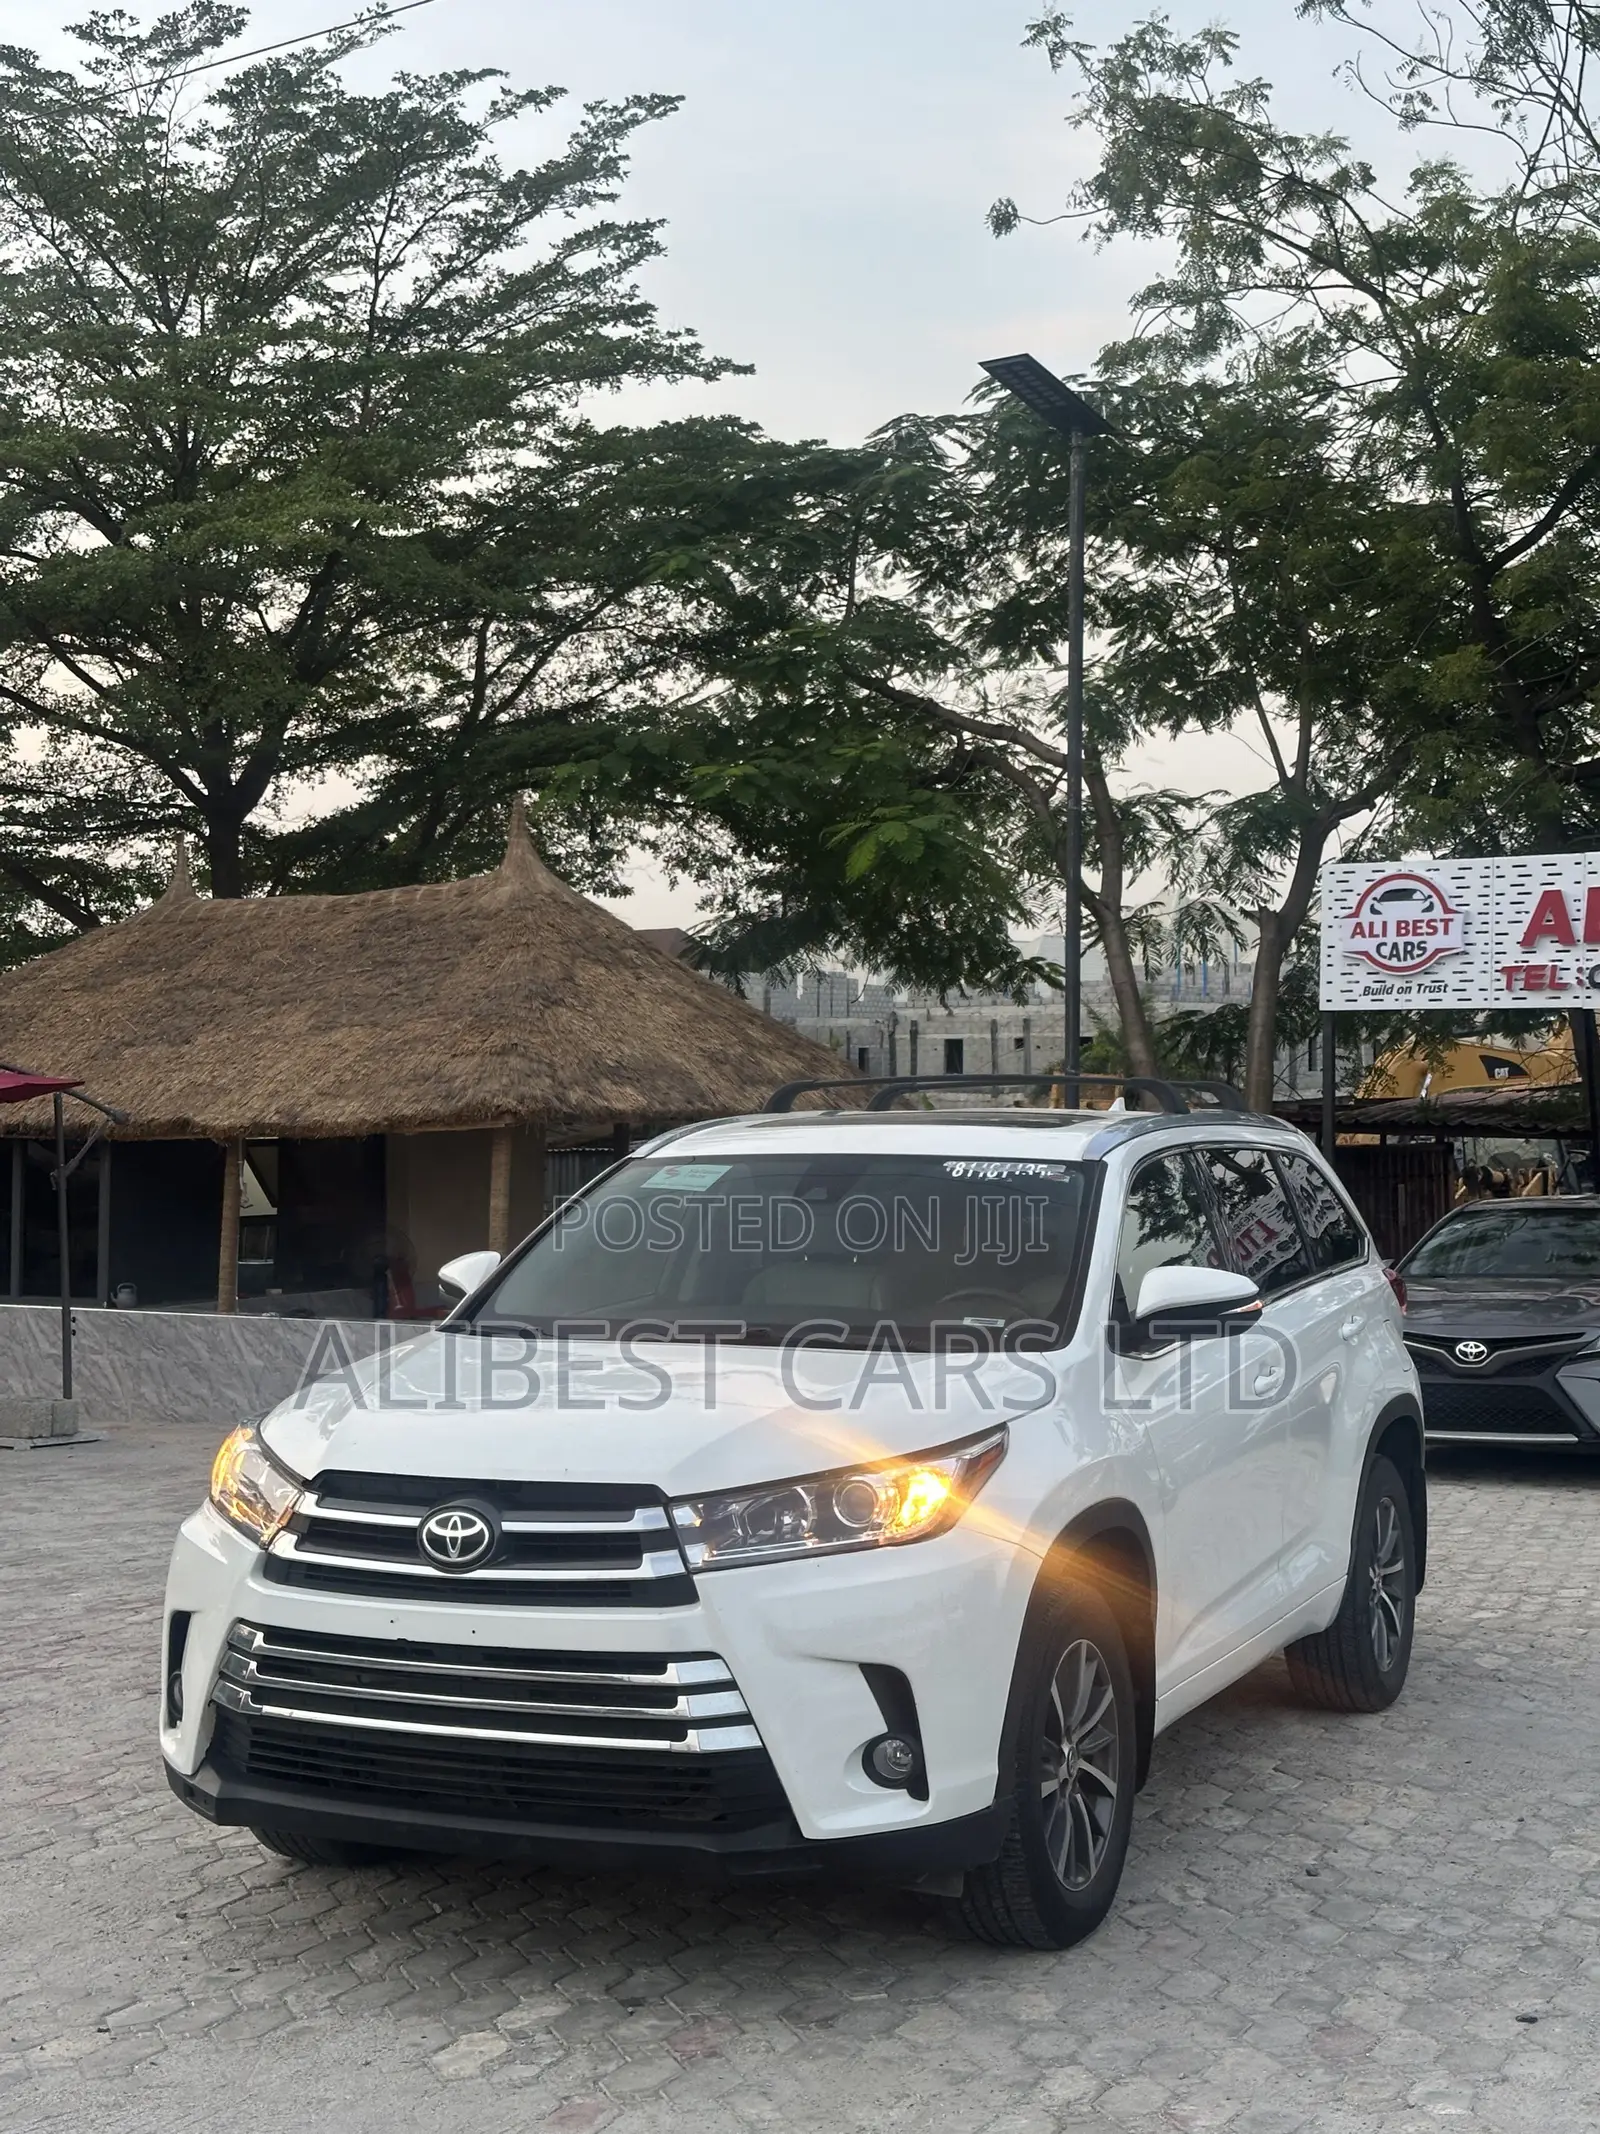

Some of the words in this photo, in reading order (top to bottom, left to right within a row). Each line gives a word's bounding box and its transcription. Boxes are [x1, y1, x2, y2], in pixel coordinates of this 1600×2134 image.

[1350, 921, 1388, 939] ALI
[1396, 918, 1454, 937] BEST
[1375, 940, 1428, 962] CARS
[1396, 986, 1412, 995] on
[1416, 982, 1449, 994] Trust
[1494, 1067, 1510, 1080] CAT
